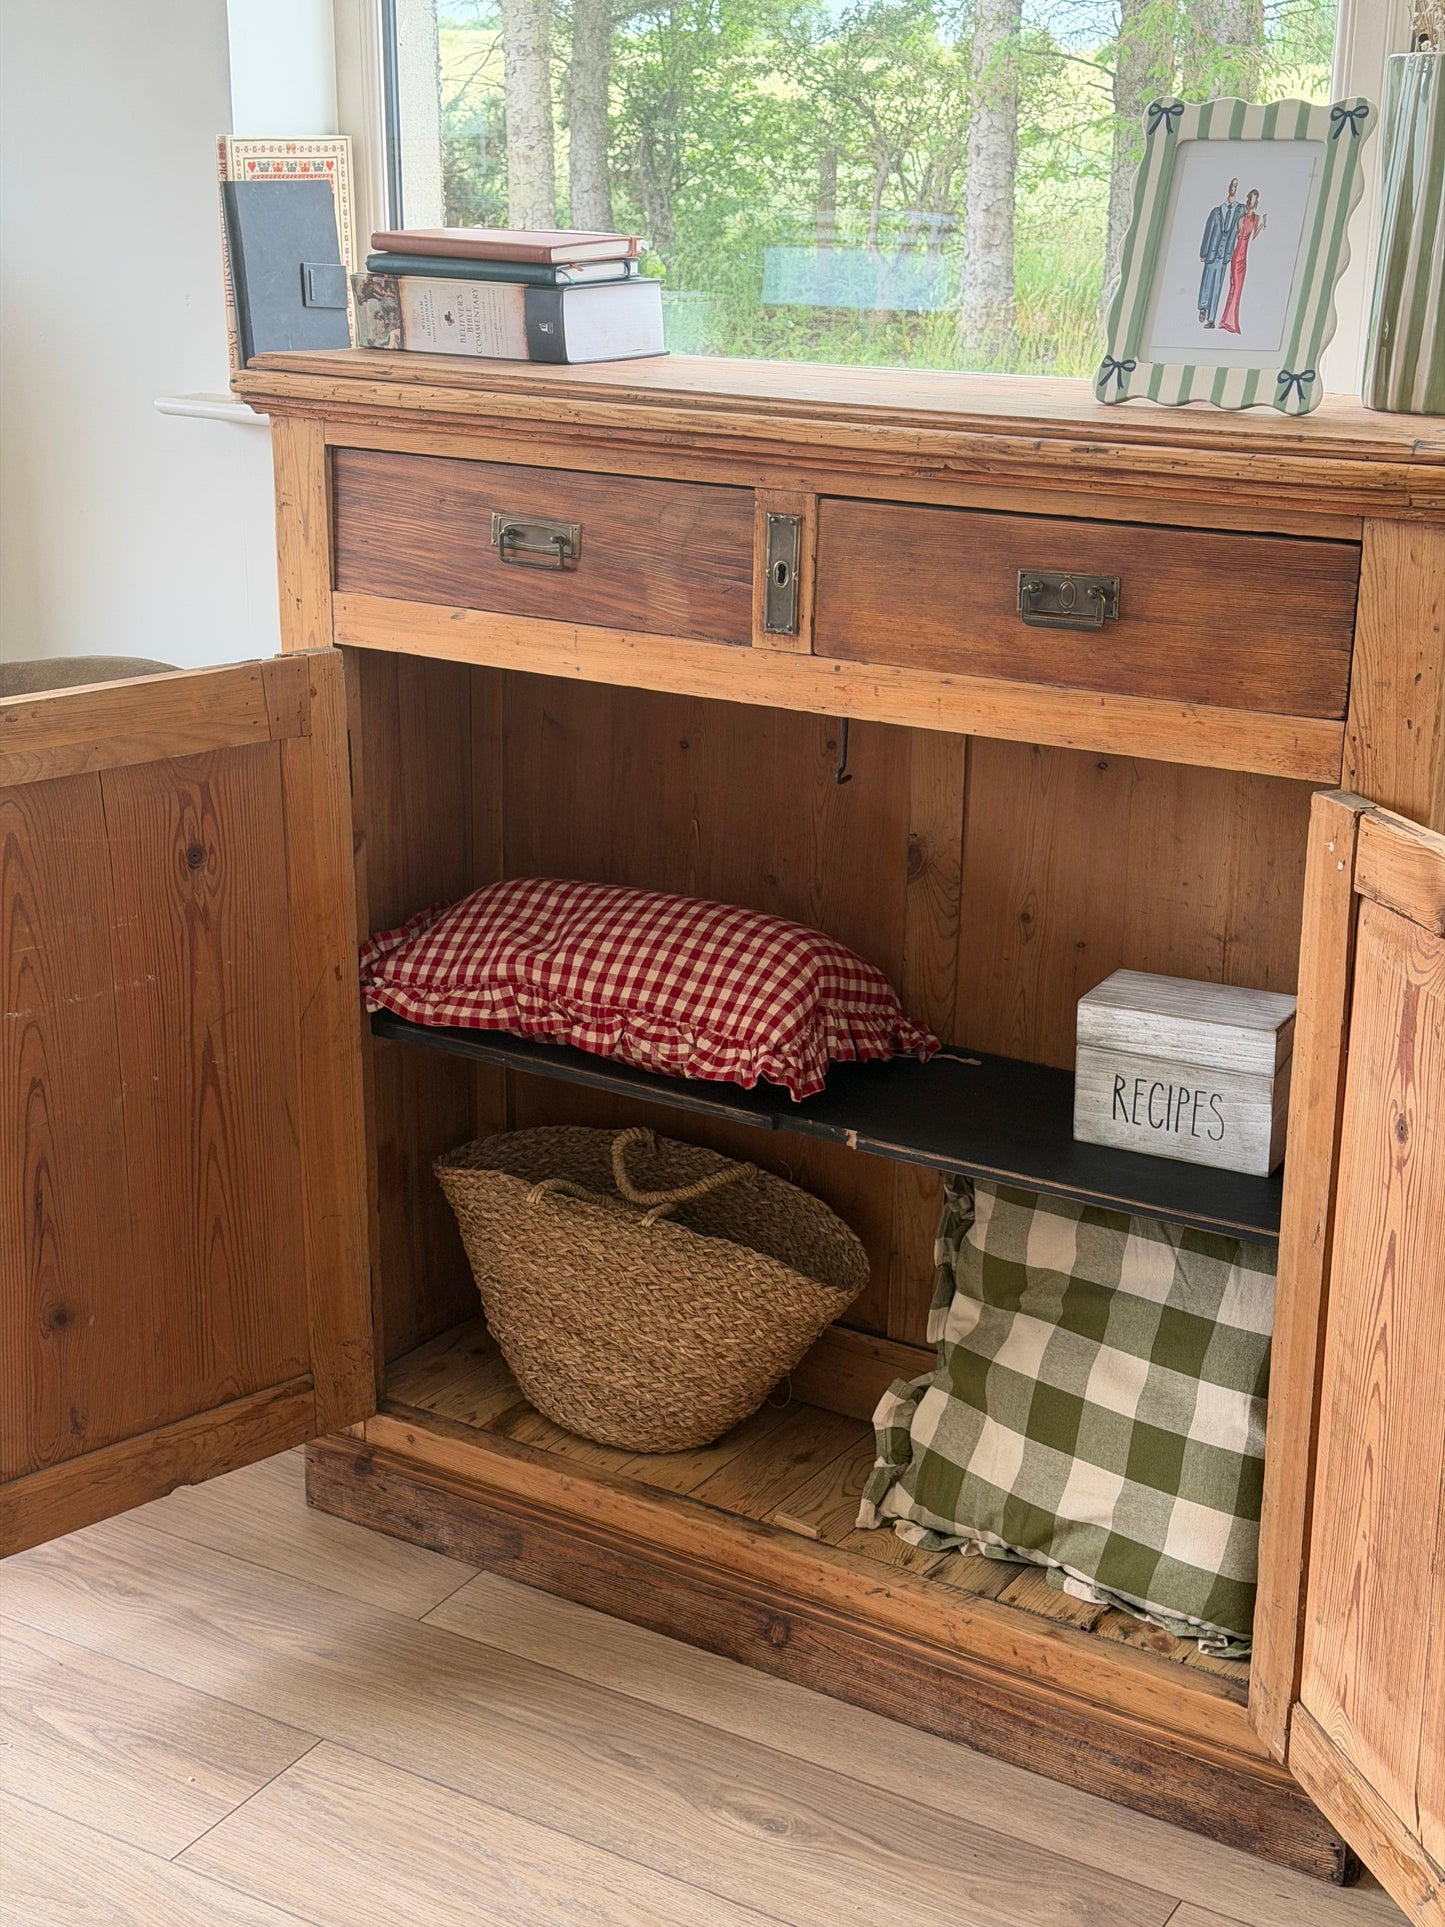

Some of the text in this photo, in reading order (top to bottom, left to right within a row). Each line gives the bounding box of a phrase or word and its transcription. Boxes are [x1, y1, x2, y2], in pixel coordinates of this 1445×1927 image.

[466, 307, 474, 333] BIBLE
[472, 288, 483, 354] COMMENTARY
[228, 327, 239, 368] Jo Verso
[1112, 1074, 1225, 1141] RECIPES
